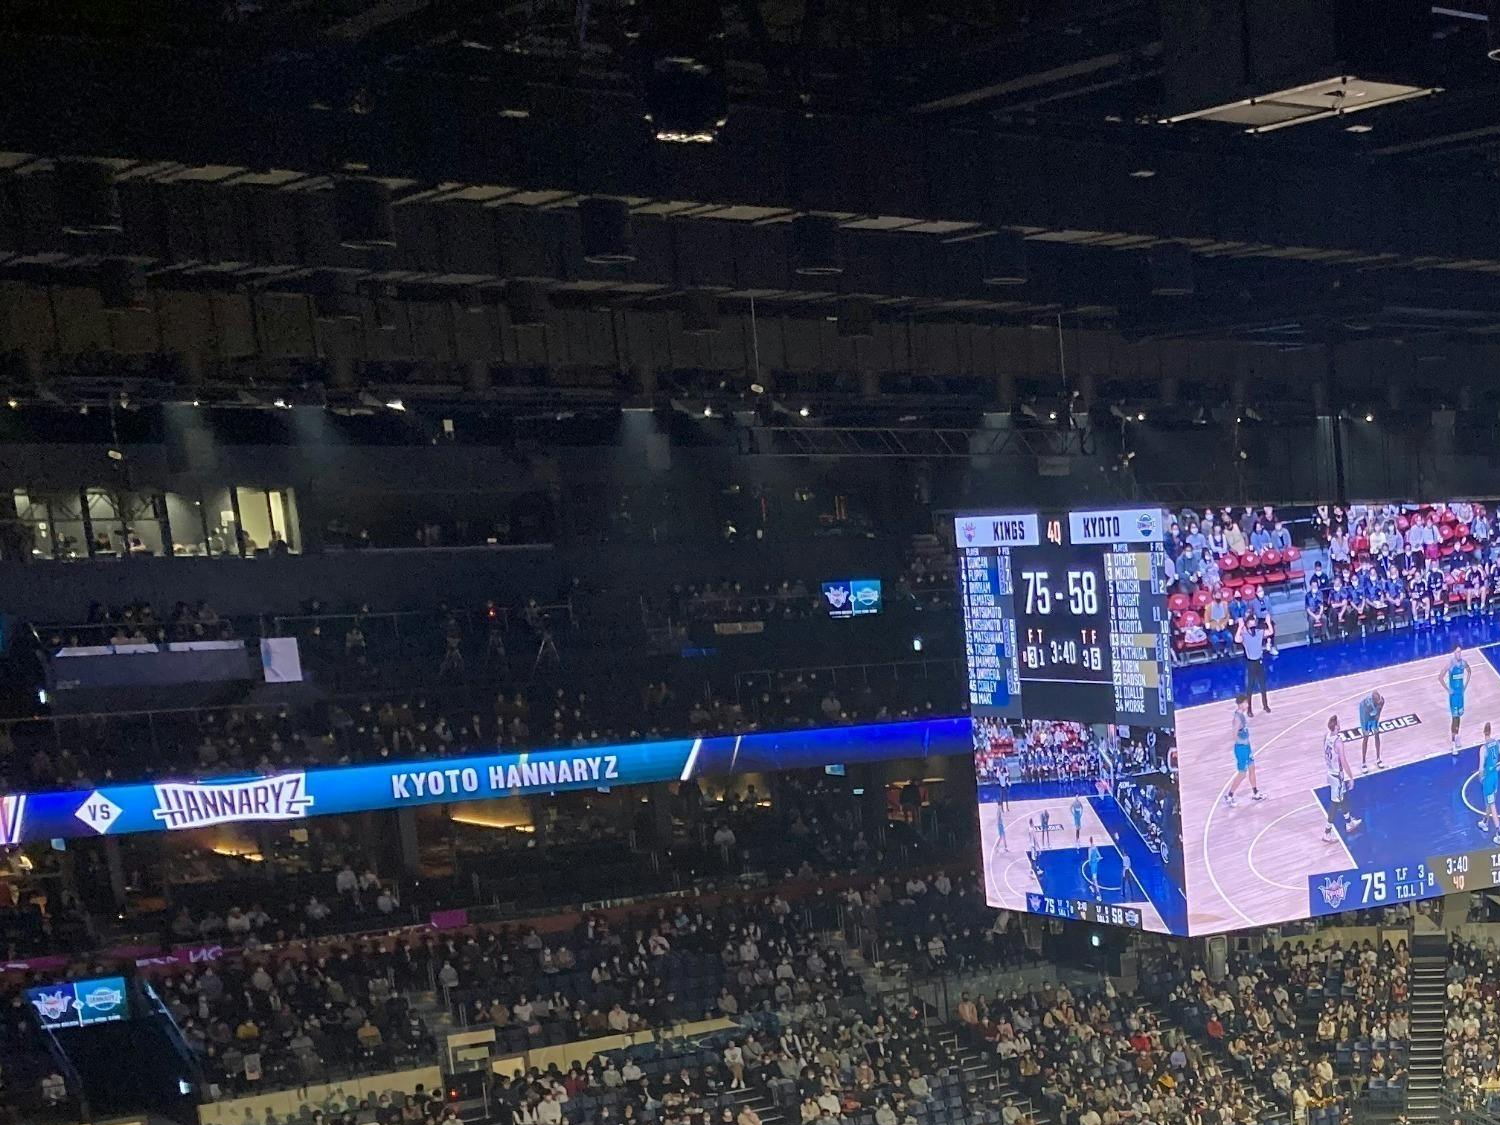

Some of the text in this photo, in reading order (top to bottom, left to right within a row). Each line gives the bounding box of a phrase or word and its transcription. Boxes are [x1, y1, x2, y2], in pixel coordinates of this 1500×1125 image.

[992, 520, 1025, 541] KINGS
[1083, 516, 1120, 538] KYOTO
[1022, 571, 1051, 614] 75
[1068, 571, 1097, 614] 58
[1050, 640, 1076, 665] 3:40
[391, 755, 619, 799] KYOTO HANNARYZ
[87, 803, 110, 821] VS
[156, 777, 311, 827] HANNARYZ
[1418, 864, 1425, 878] 3
[1446, 856, 1468, 875] 3:40
[1360, 871, 1387, 903] 75
